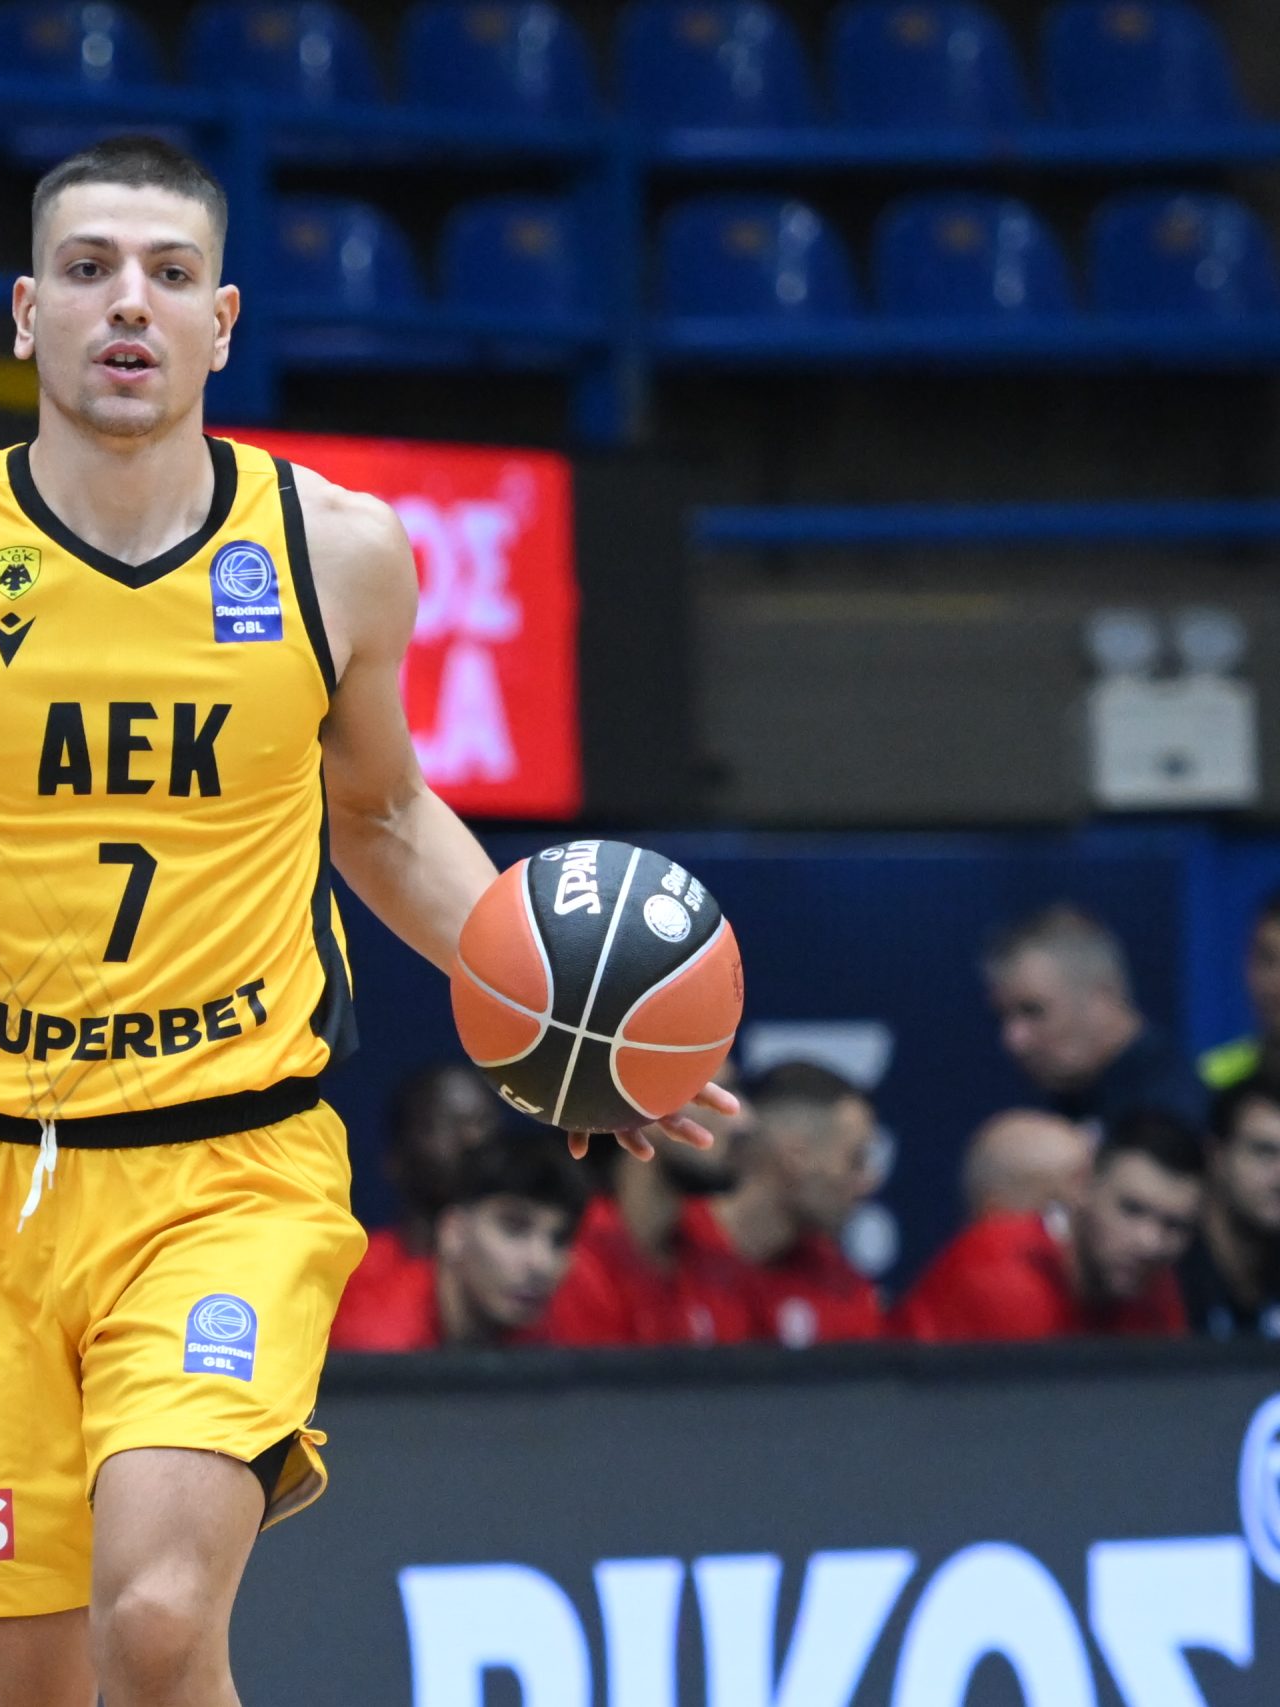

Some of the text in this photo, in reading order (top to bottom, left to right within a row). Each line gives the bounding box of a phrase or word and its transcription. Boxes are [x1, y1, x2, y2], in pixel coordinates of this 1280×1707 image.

[232, 620, 266, 634] GBL
[37, 701, 232, 797] AEK
[98, 842, 158, 962] 7
[202, 1356, 236, 1371] GBL
